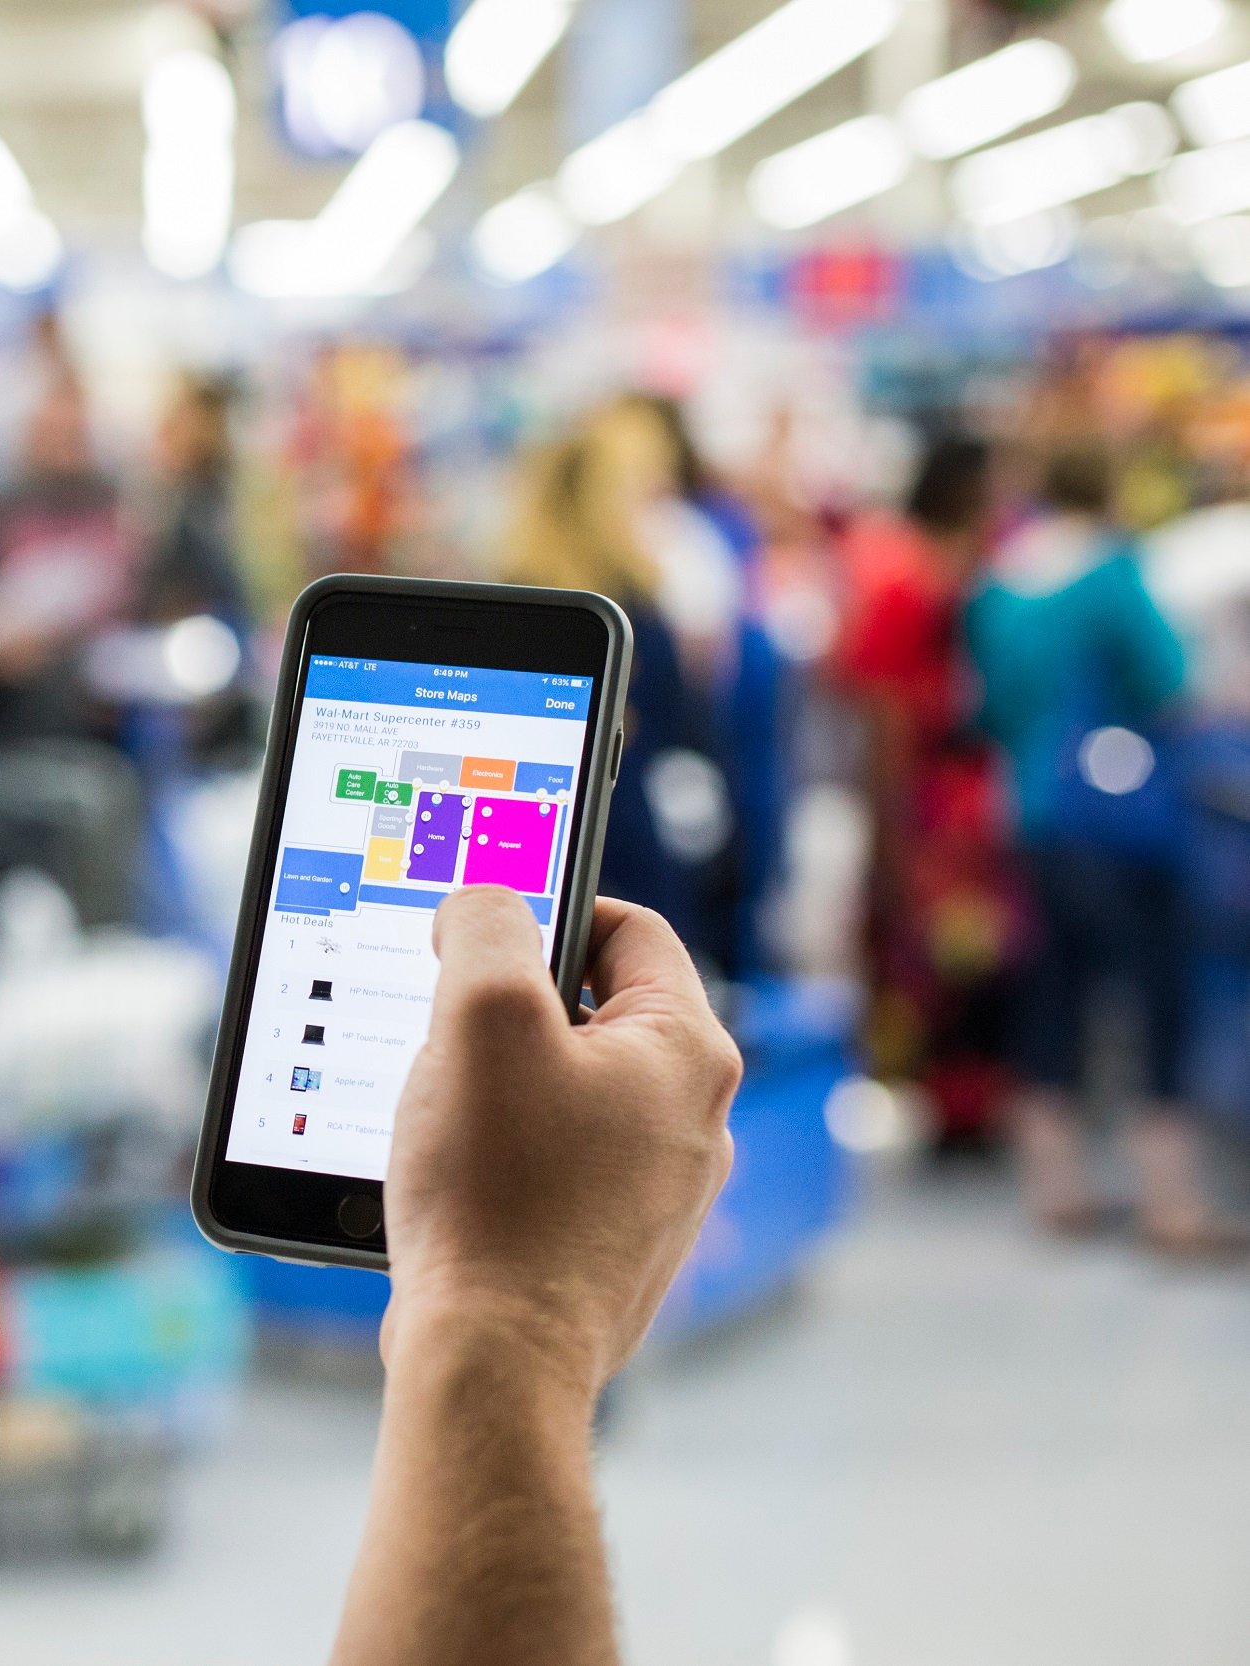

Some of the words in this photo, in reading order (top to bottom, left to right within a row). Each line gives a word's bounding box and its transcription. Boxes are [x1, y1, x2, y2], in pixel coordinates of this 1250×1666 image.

[338, 661, 359, 670] AT&T
[363, 662, 377, 671] LTE
[433, 668, 452, 678] 6:49
[453, 670, 468, 679] PM
[551, 677, 569, 687] 63%
[414, 687, 445, 700] Store
[447, 690, 478, 703] Maps
[545, 698, 575, 710] Done
[316, 707, 371, 722] Wal-Mart
[373, 711, 447, 728] Supercenter
[450, 718, 481, 730] #359
[313, 721, 334, 731] 3919
[353, 724, 378, 735] MALL
[380, 727, 399, 736] AVE
[311, 732, 374, 746] FAYETTEVILLE,
[377, 738, 390, 747] AR
[392, 739, 419, 750] 72703
[472, 769, 503, 779] Electronics
[548, 776, 564, 784] Food
[345, 789, 365, 797] Center
[379, 814, 403, 824] Sporting
[427, 833, 446, 841] Home
[498, 841, 521, 849] Apparel
[283, 872, 299, 881] Lawn
[300, 874, 311, 882] and
[312, 875, 333, 884] Garden
[280, 914, 300, 925] Hot
[303, 917, 334, 928] Deals
[289, 939, 295, 949] 1
[356, 942, 379, 952] Drone
[381, 945, 415, 956] Phantom
[281, 984, 288, 994] 2
[350, 986, 362, 995] HP
[273, 1028, 280, 1038] 3
[342, 1032, 355, 1040] HP
[356, 1033, 379, 1044] Touch
[379, 1036, 406, 1047] Laptop
[266, 1073, 274, 1083] 4
[334, 1077, 356, 1087] Apple
[357, 1080, 375, 1089] iPad
[258, 1118, 266, 1128] 5
[327, 1121, 343, 1131] RCA
